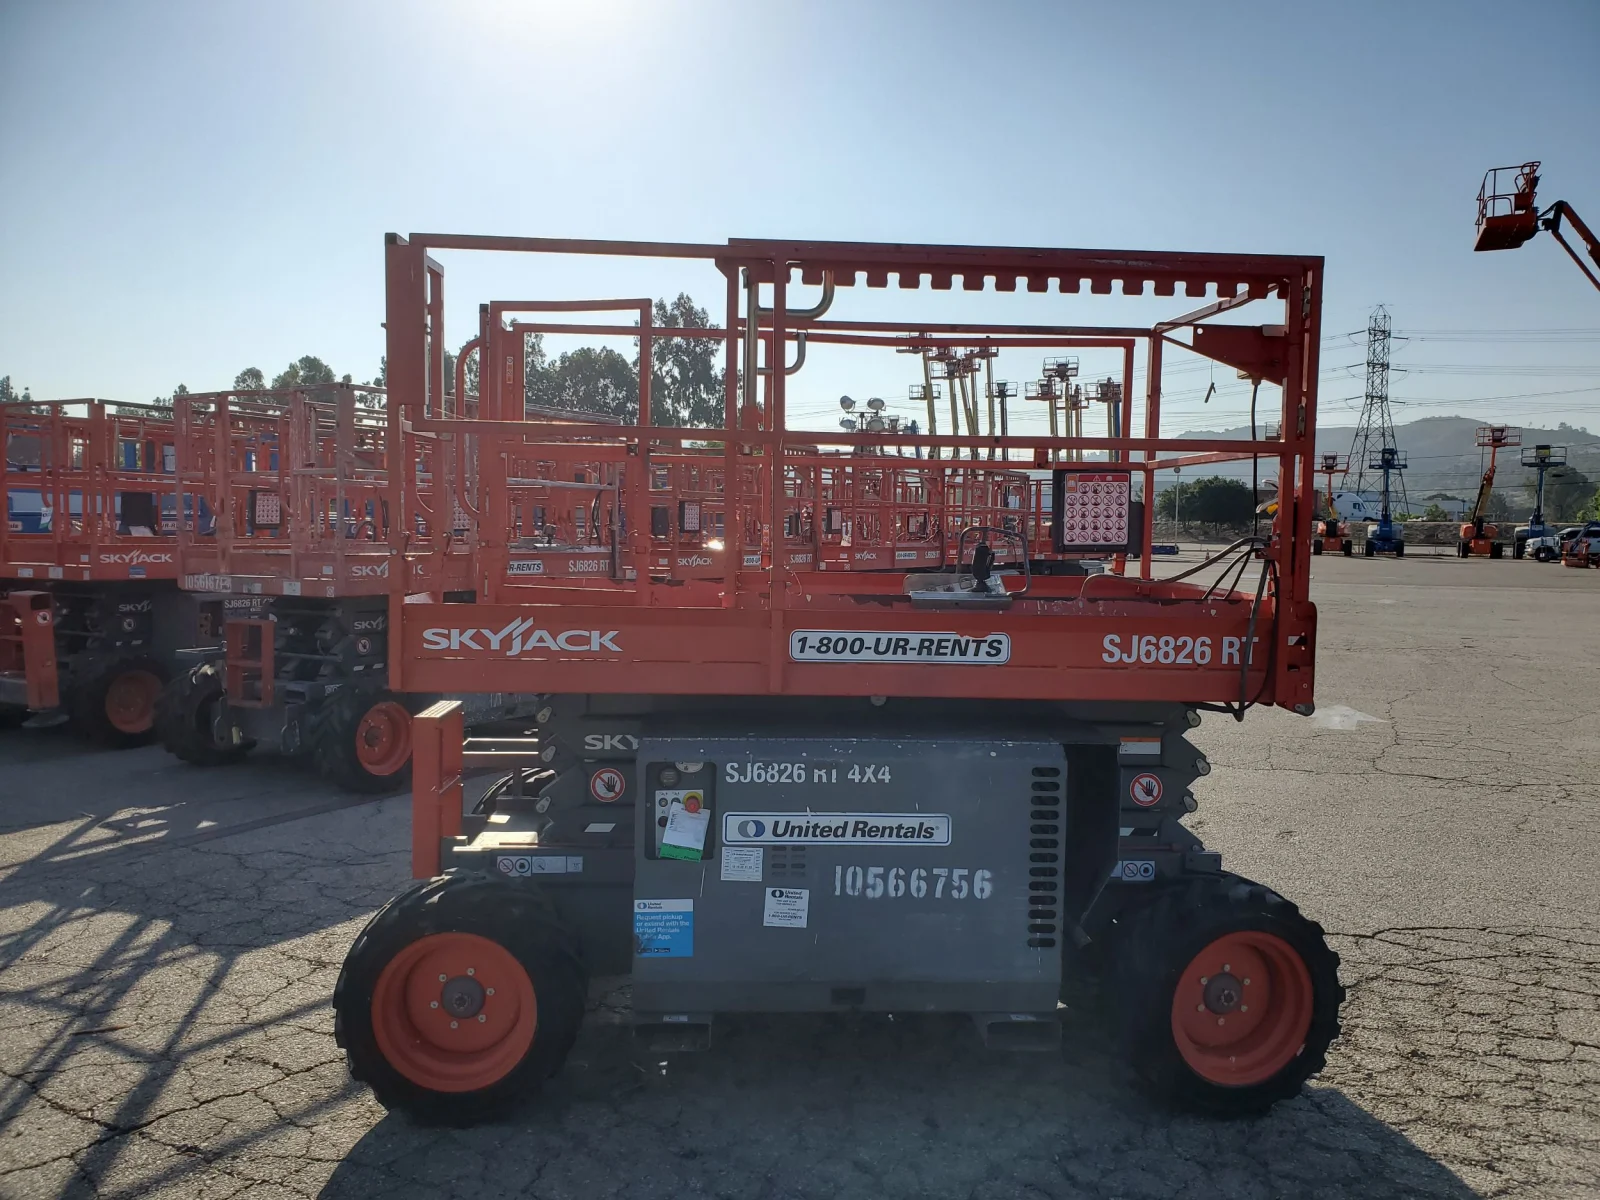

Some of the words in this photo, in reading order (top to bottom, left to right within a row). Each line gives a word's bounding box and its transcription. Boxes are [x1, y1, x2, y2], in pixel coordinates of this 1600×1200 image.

[100, 549, 173, 565] SKYJACK
[568, 560, 598, 573] SJ6826
[599, 560, 610, 572] RT
[678, 554, 713, 568] SKYJACK
[224, 599, 251, 609] SJ6826
[422, 616, 624, 656] SKYJACK
[797, 636, 1004, 658] 1-800-UR-RENTS
[1101, 634, 1212, 665] SJ6826
[1221, 636, 1260, 665] RT
[725, 762, 806, 783] SJ6826
[847, 764, 892, 783] 4X4
[771, 820, 849, 839] United
[851, 820, 935, 840] Rentals
[834, 865, 993, 900] 10566756
[662, 913, 683, 921] pickup
